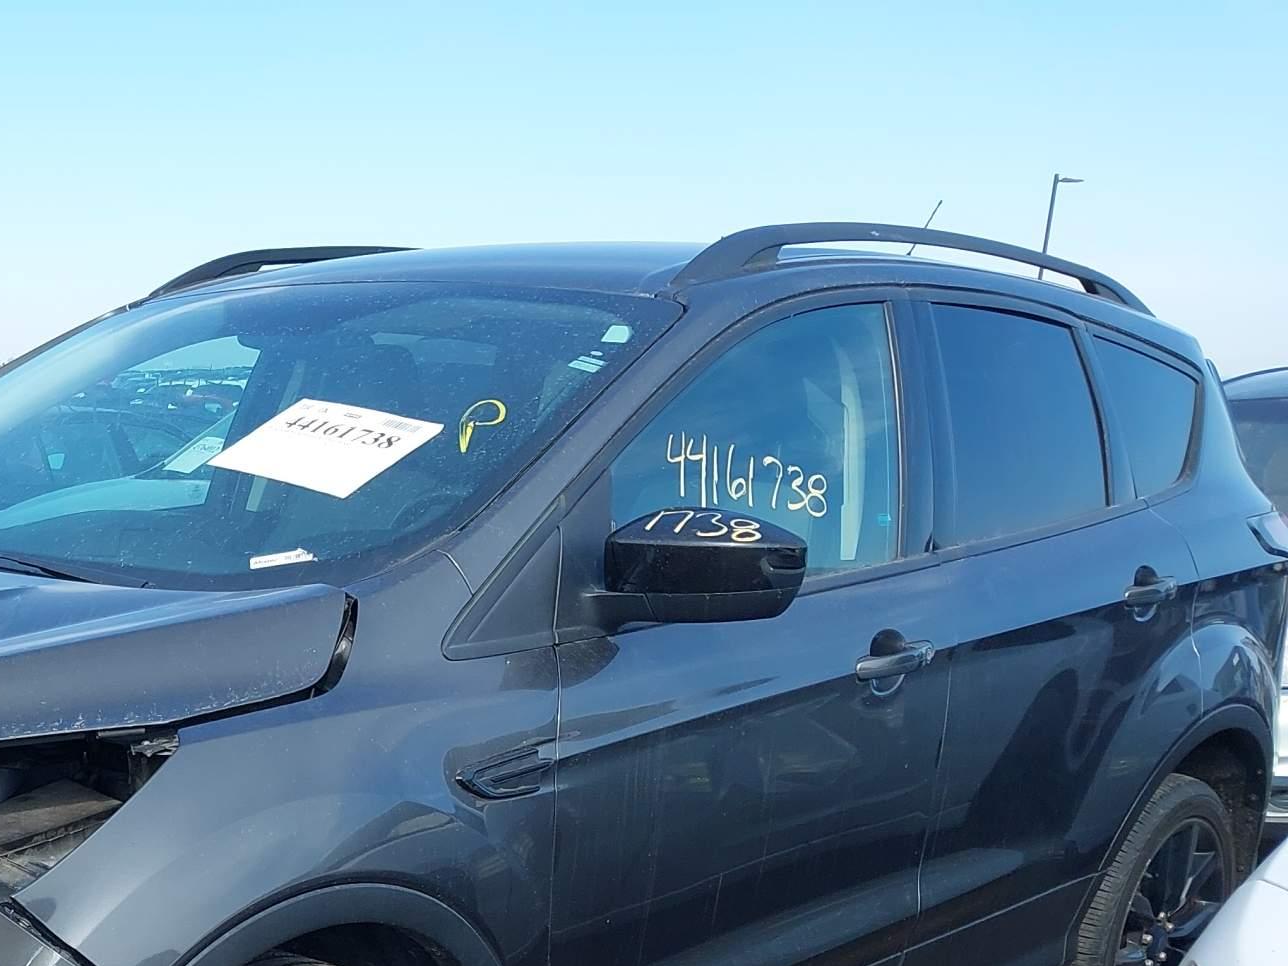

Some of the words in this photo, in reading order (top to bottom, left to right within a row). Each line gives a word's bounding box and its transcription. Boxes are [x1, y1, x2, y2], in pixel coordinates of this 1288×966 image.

[285, 416, 401, 449] 44161738
[459, 399, 507, 453] P
[667, 431, 828, 518] 44161738
[644, 510, 762, 542] 1738
